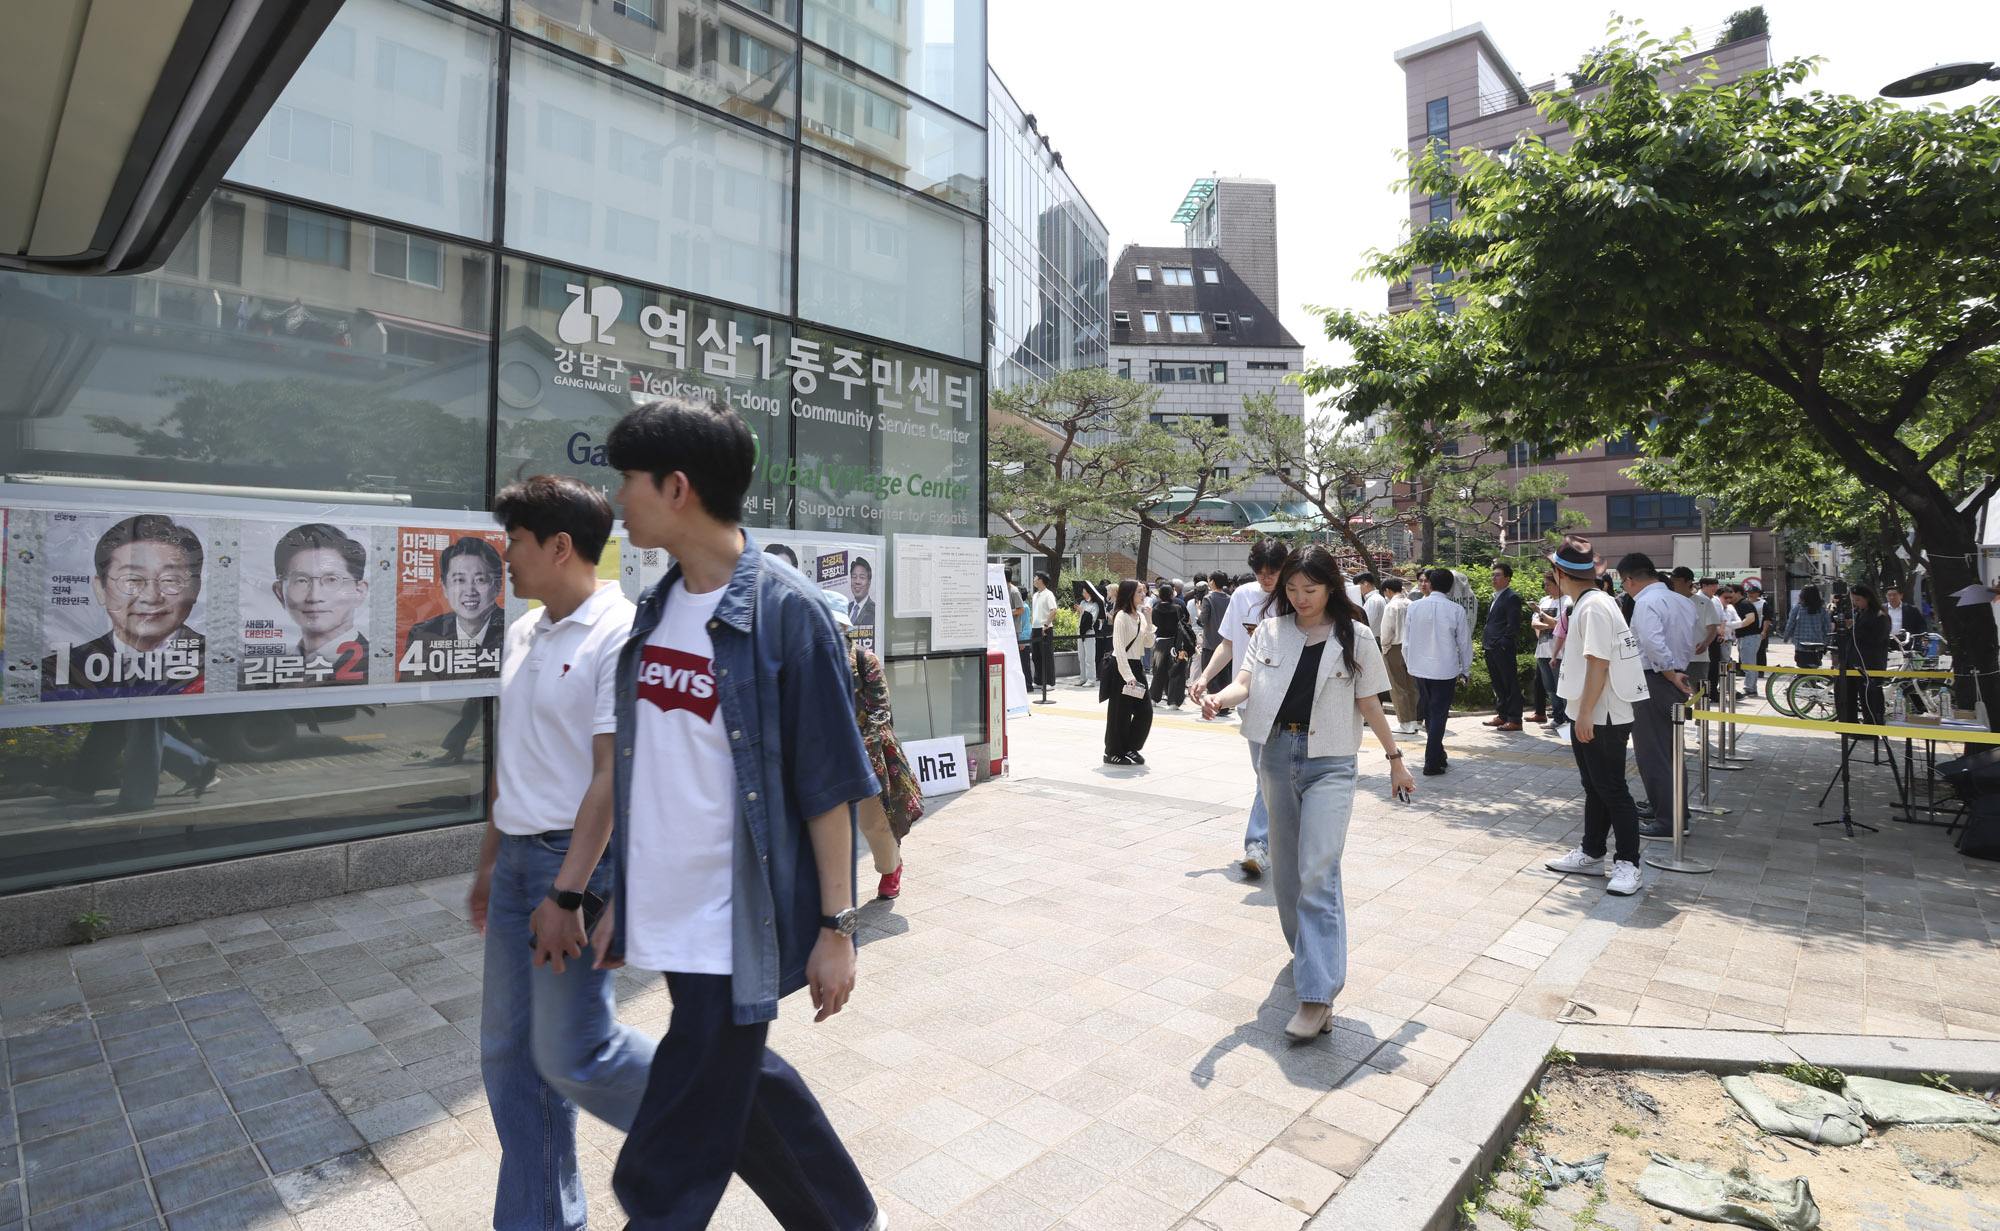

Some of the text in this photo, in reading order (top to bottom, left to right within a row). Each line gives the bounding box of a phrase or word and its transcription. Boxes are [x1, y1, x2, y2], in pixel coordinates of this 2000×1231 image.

[553, 347, 624, 381] 강남구
[639, 304, 973, 422] 역삼1동주민센터
[639, 370, 971, 445] Yeoksam 1-dong Community Service Center
[759, 455, 823, 488] lobal
[828, 463, 903, 501] Village
[907, 473, 971, 500] Center
[798, 500, 856, 519] Support
[860, 505, 904, 521] Center
[908, 508, 925, 522] for
[929, 510, 968, 526] Expats
[402, 533, 450, 551] 미래를
[402, 550, 434, 566] 여는
[821, 553, 844, 568] 선경제,
[51, 575, 90, 584] 이제부터
[401, 566, 434, 583] 선택
[821, 565, 845, 579] 후정치!
[1715, 571, 1736, 580] 배부
[51, 586, 72, 595] 진짜
[51, 597, 90, 606] 대한민국
[987, 606, 1007, 618] 선거인
[244, 619, 274, 629] 새롭게
[244, 629, 283, 638] 대한민국
[166, 639, 200, 649] 지금은
[246, 645, 284, 655] 정정당당
[429, 639, 477, 648] 새로운 대통령
[50, 642, 200, 685] 1 이재명
[243, 641, 364, 685] 김문수 2
[398, 640, 500, 676] 4 이준석
